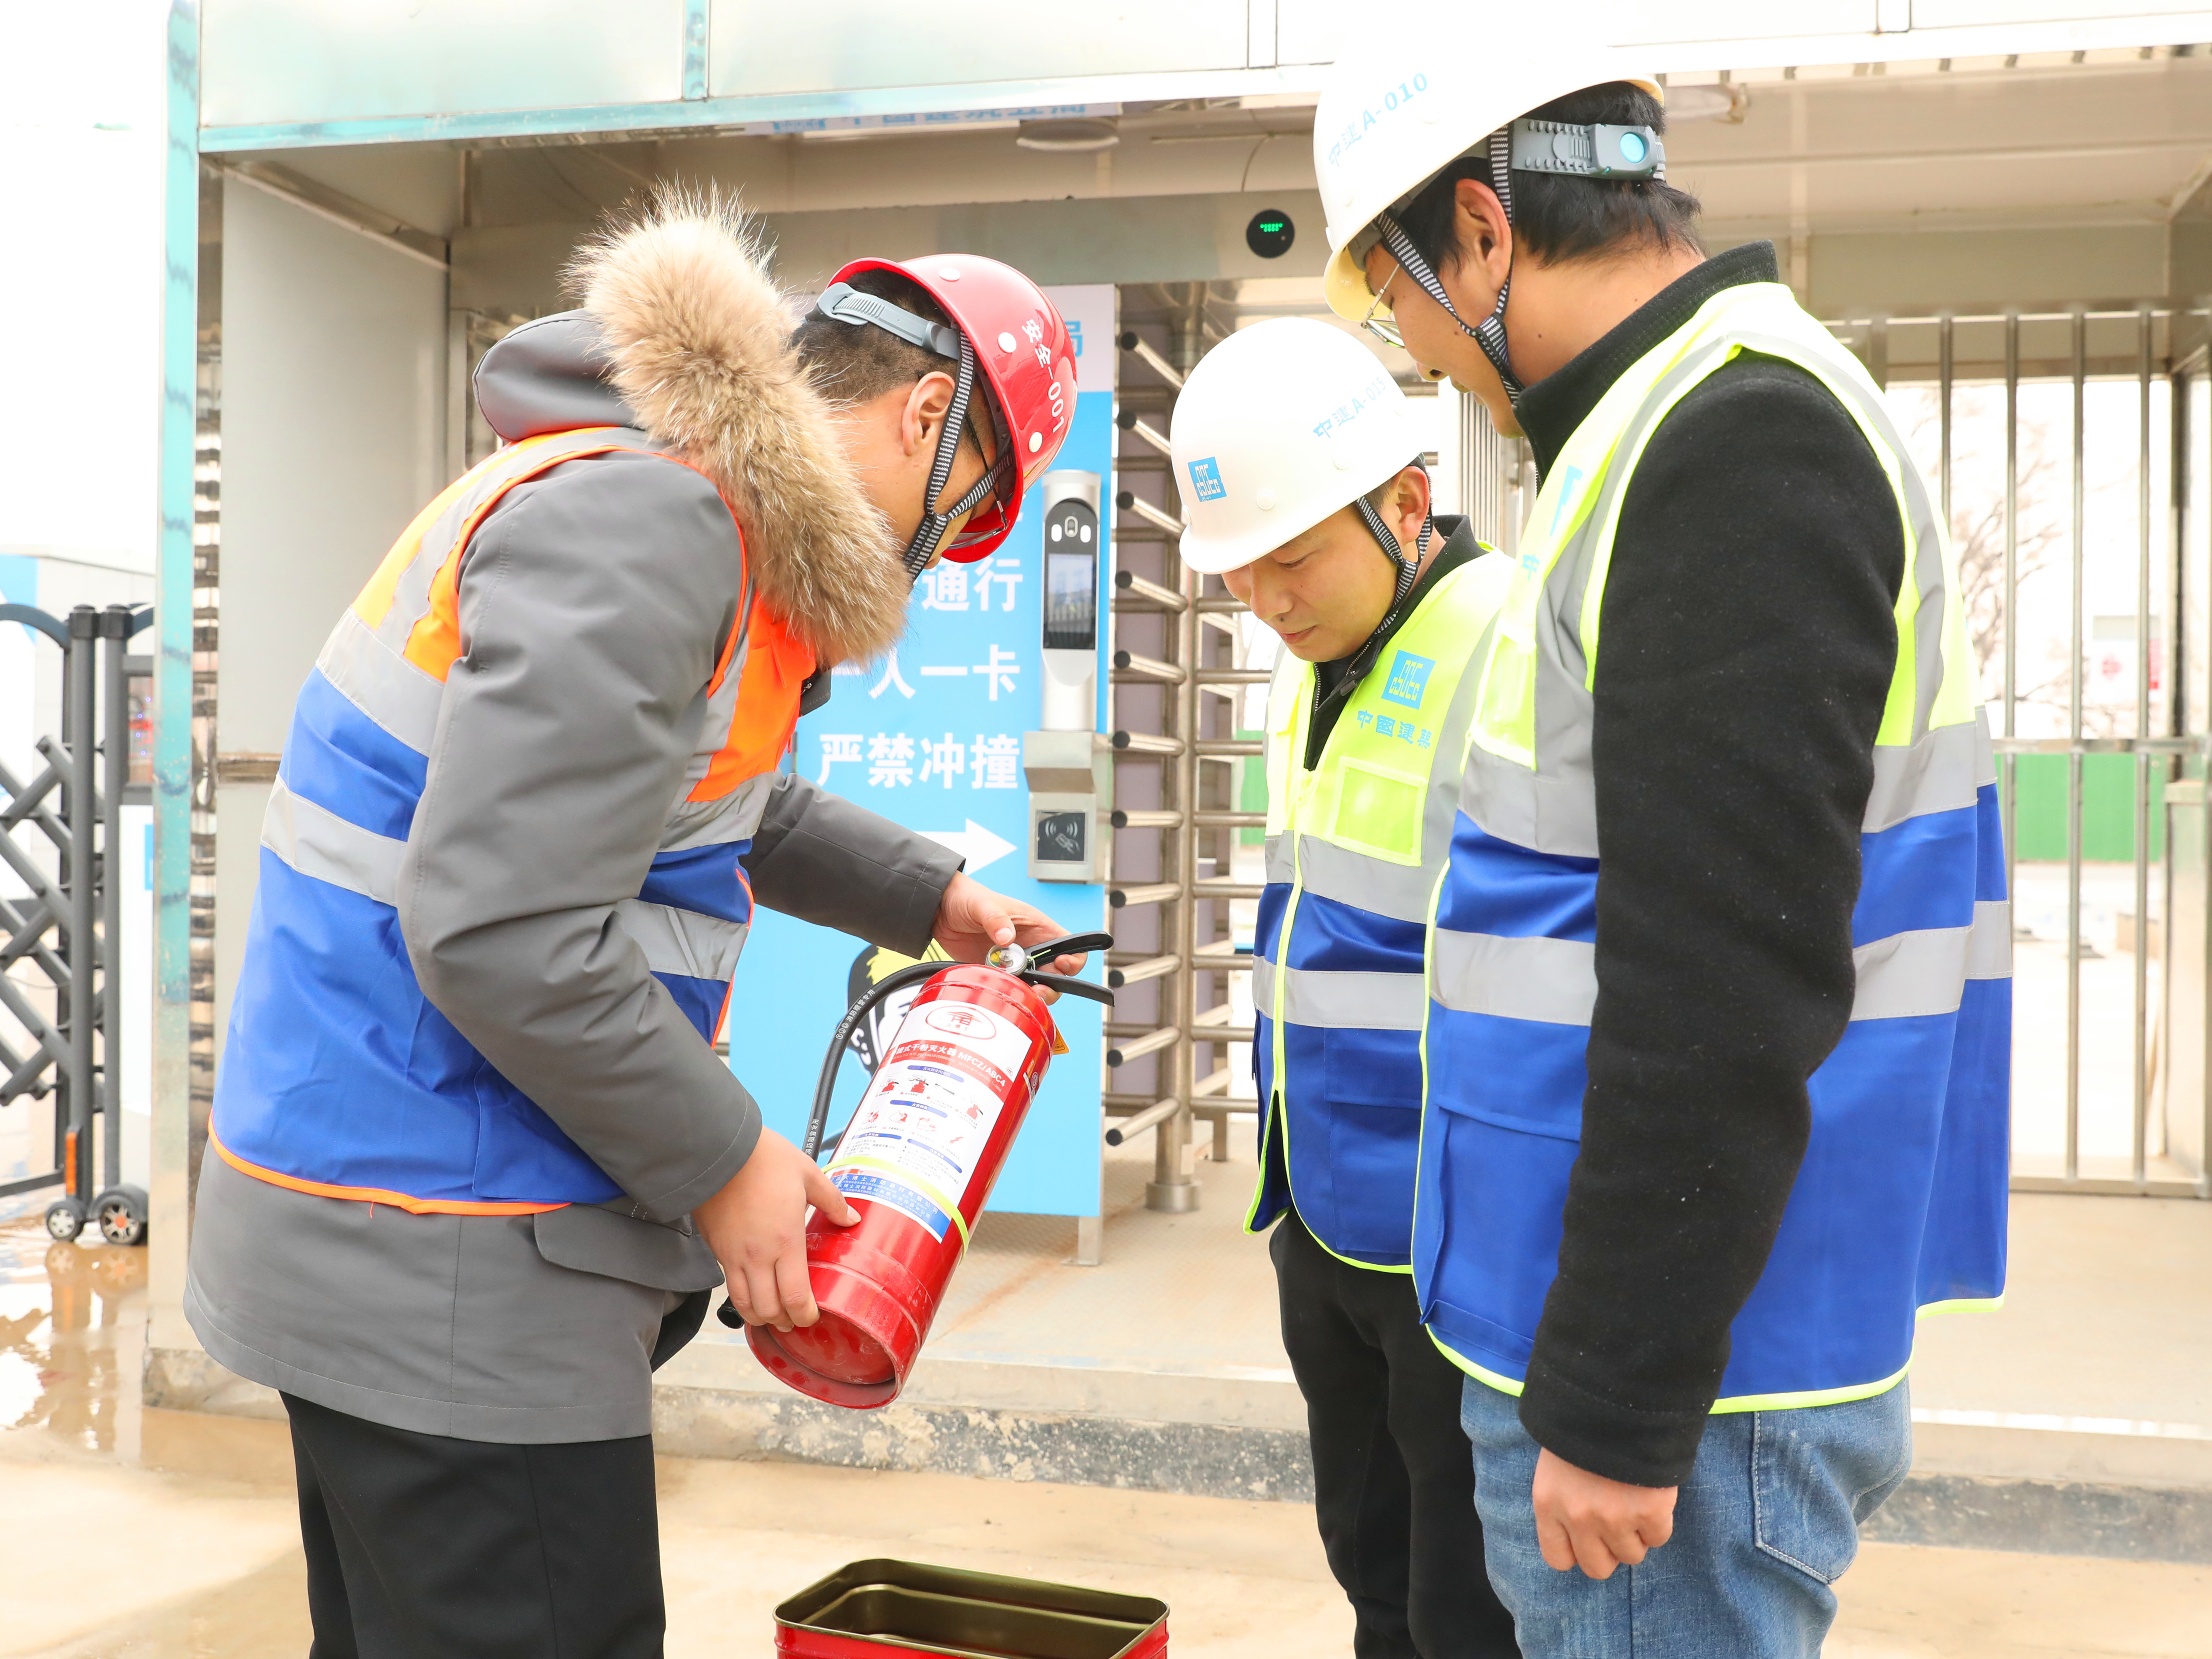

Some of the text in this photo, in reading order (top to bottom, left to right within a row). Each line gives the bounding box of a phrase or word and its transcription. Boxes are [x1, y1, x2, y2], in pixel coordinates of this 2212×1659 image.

[1022, 319, 1064, 433] 安全-001
[922, 557, 1023, 611] 通行
[817, 732, 1020, 789] 严禁冲撞
[958, 1051, 1007, 1087] MFCZ/ABC4
